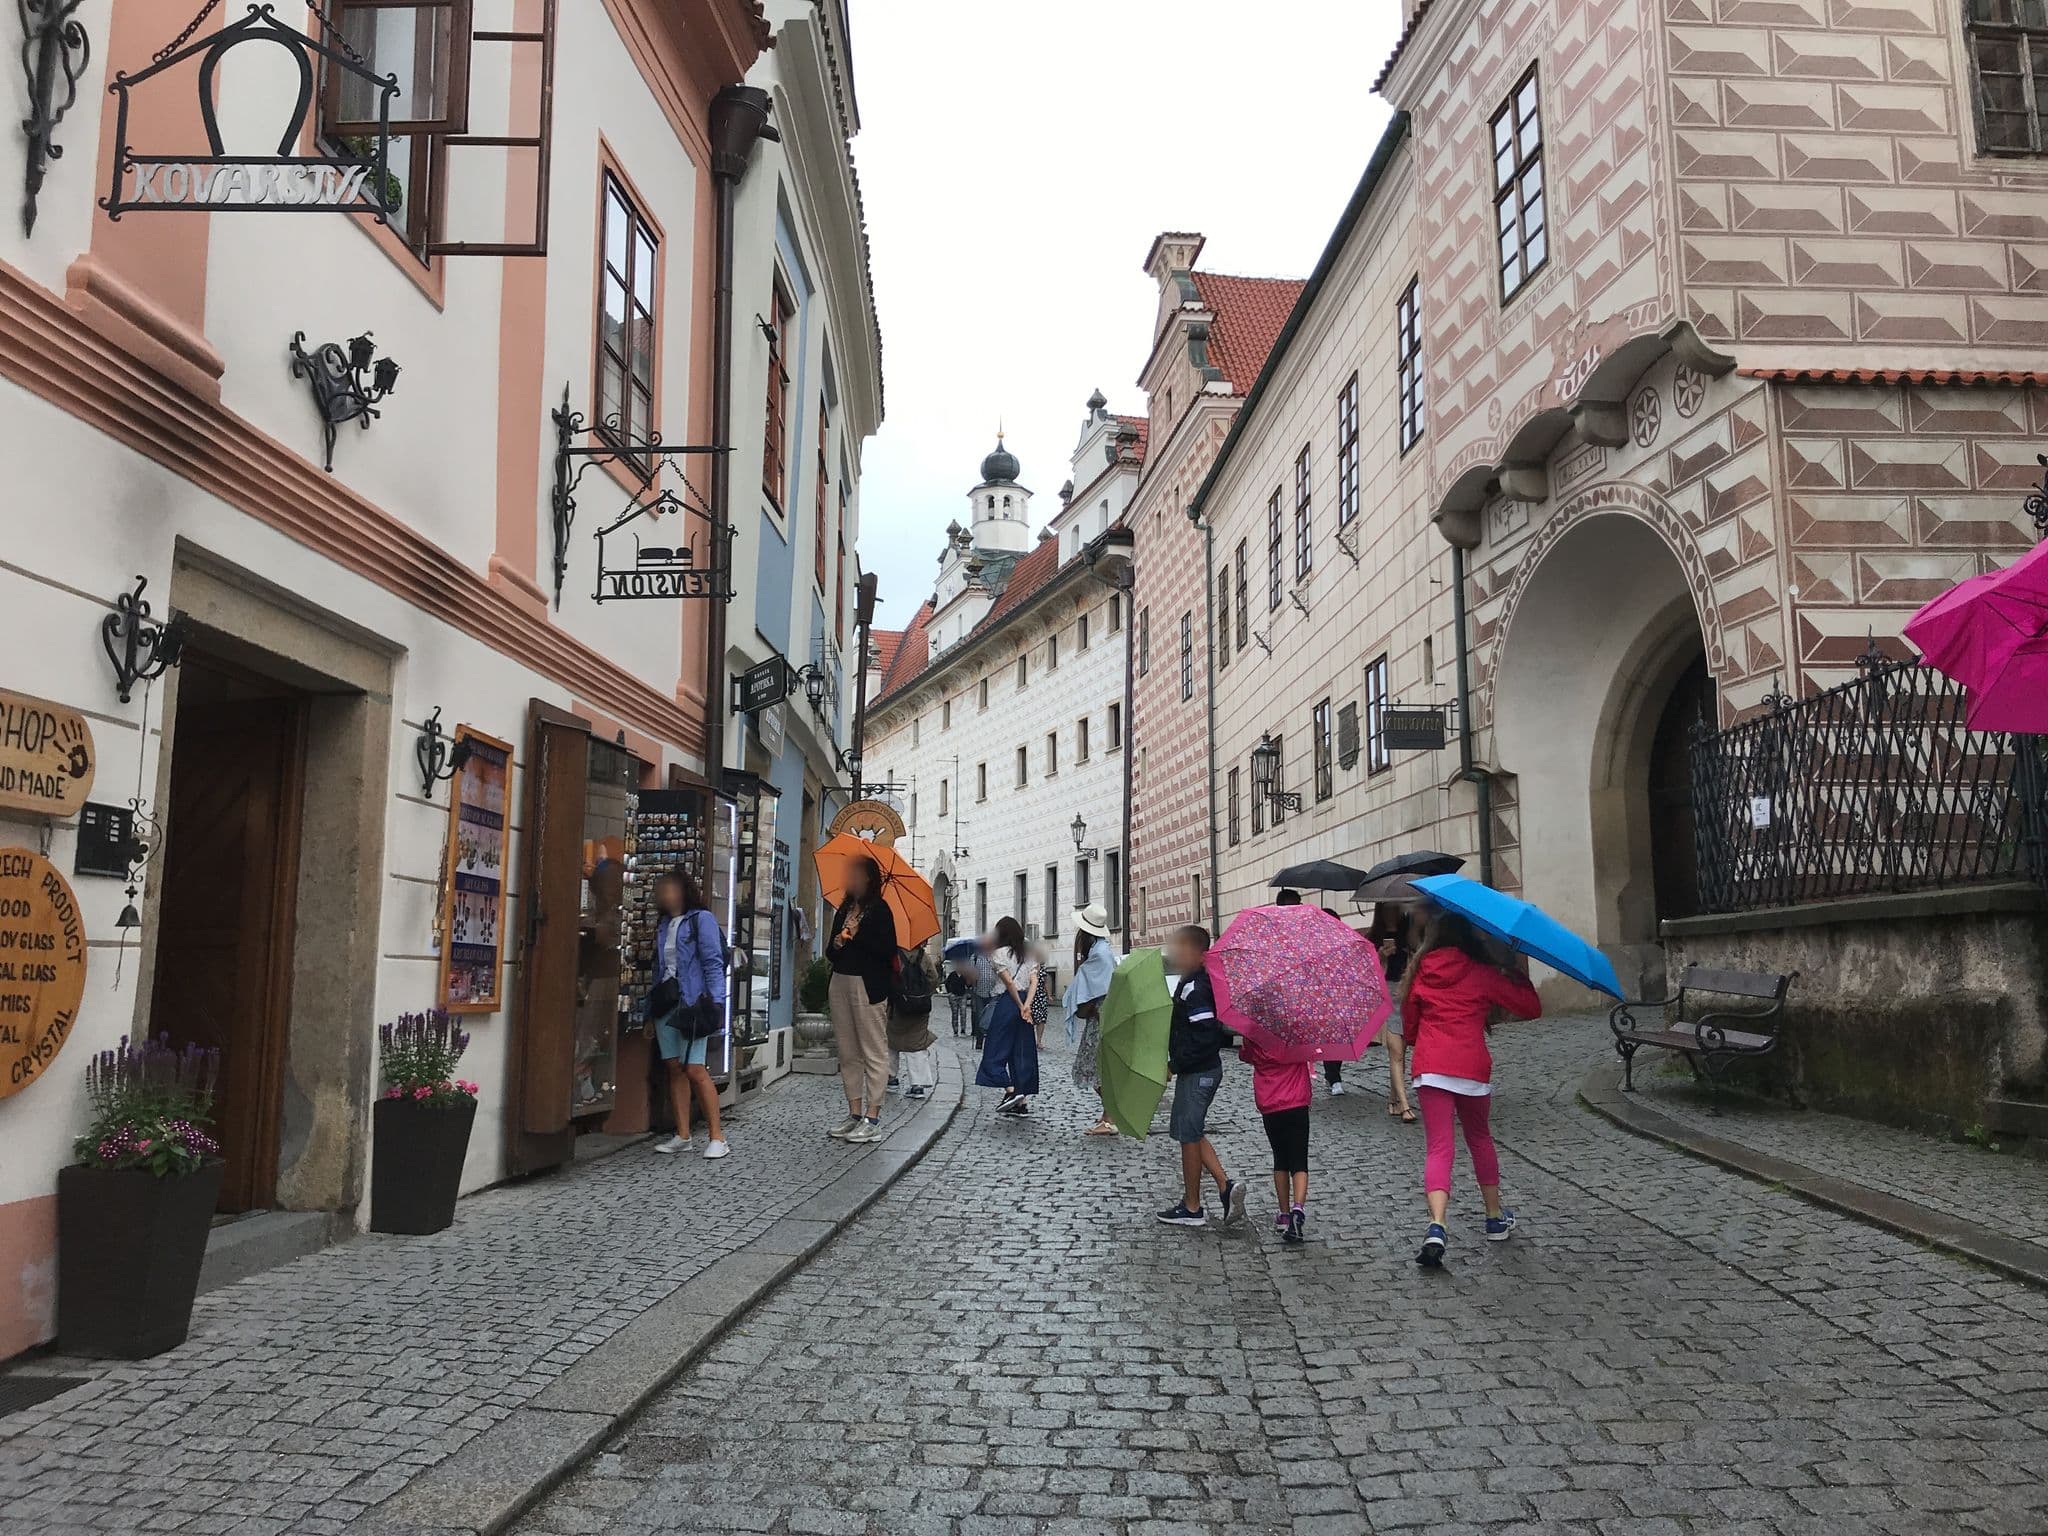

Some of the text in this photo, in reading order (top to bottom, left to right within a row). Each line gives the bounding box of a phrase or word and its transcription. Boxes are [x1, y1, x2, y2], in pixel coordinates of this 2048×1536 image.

[20, 769, 66, 800] MADE
[0, 855, 82, 964] ECH PRODUCT
[20, 932, 56, 951] GLASS
[22, 963, 57, 982] GLASS
[11, 1009, 73, 1084] CRYSTAL
